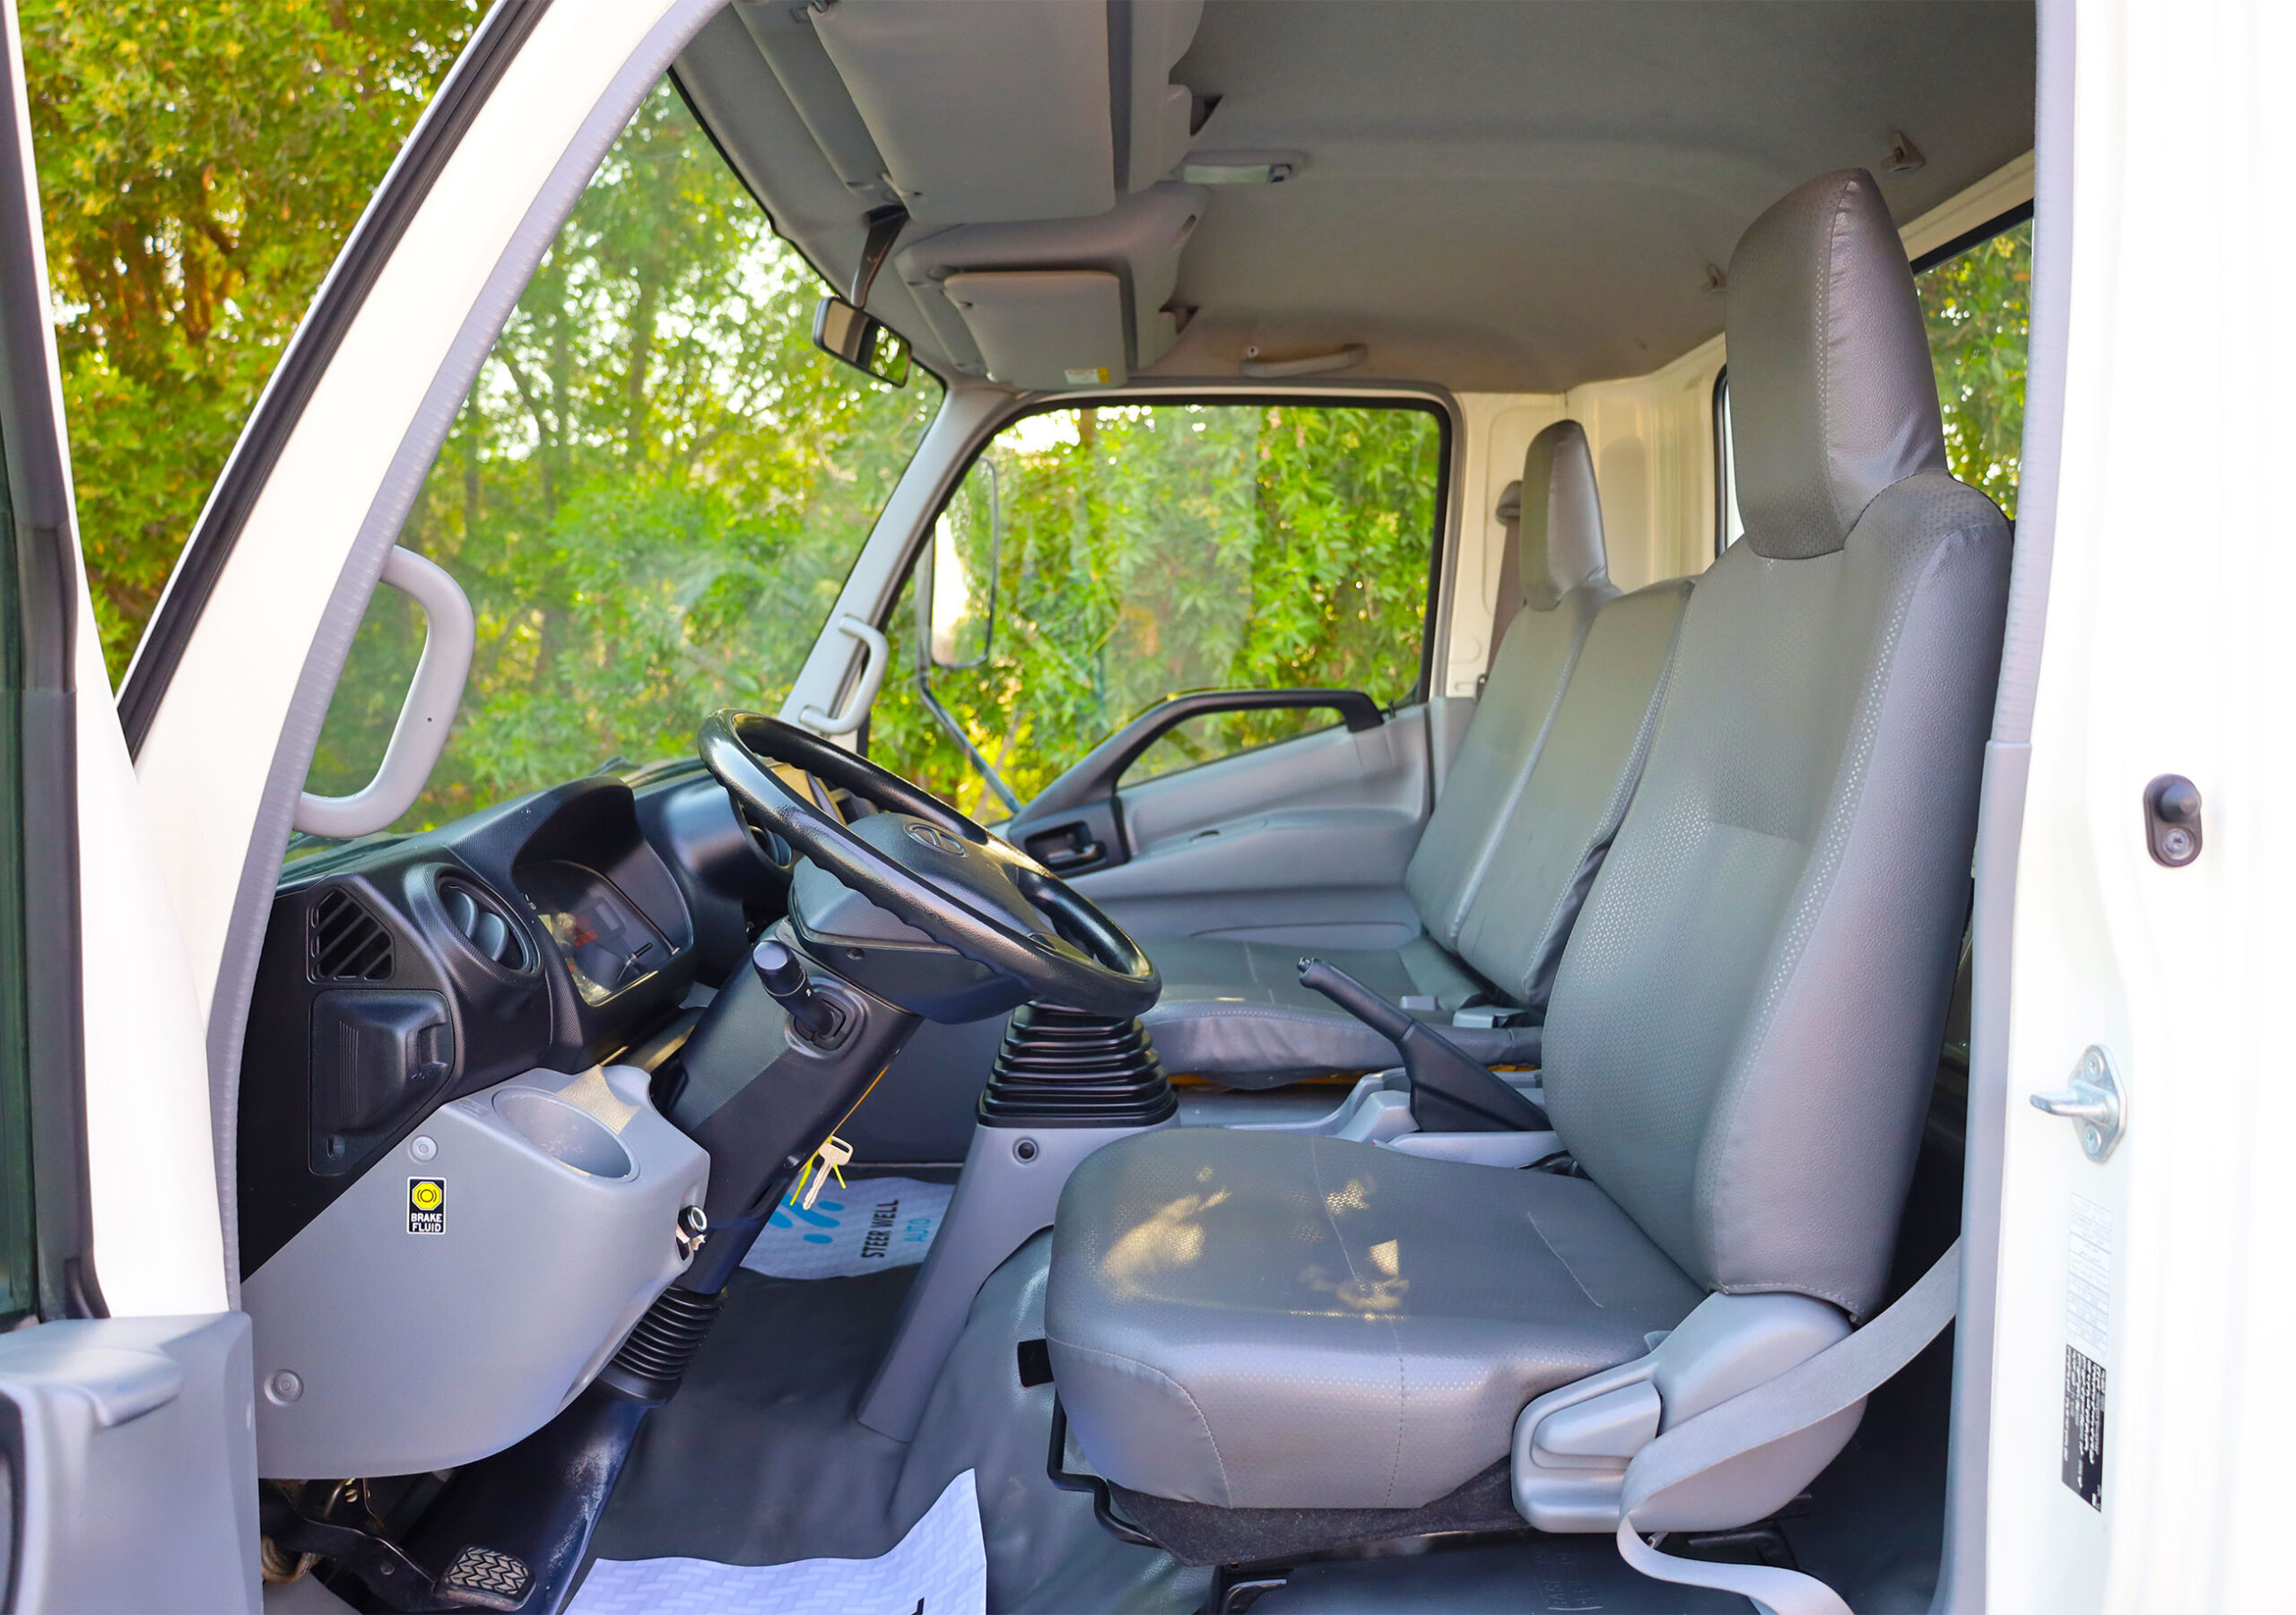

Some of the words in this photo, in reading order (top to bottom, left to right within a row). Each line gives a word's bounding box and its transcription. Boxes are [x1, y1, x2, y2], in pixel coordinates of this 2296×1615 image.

[411, 1212, 442, 1222] BRAKE
[870, 1199, 900, 1228] WELL
[412, 1222, 441, 1232] FLUID
[904, 1218, 931, 1242] AUTO
[861, 1230, 891, 1258] STEER
